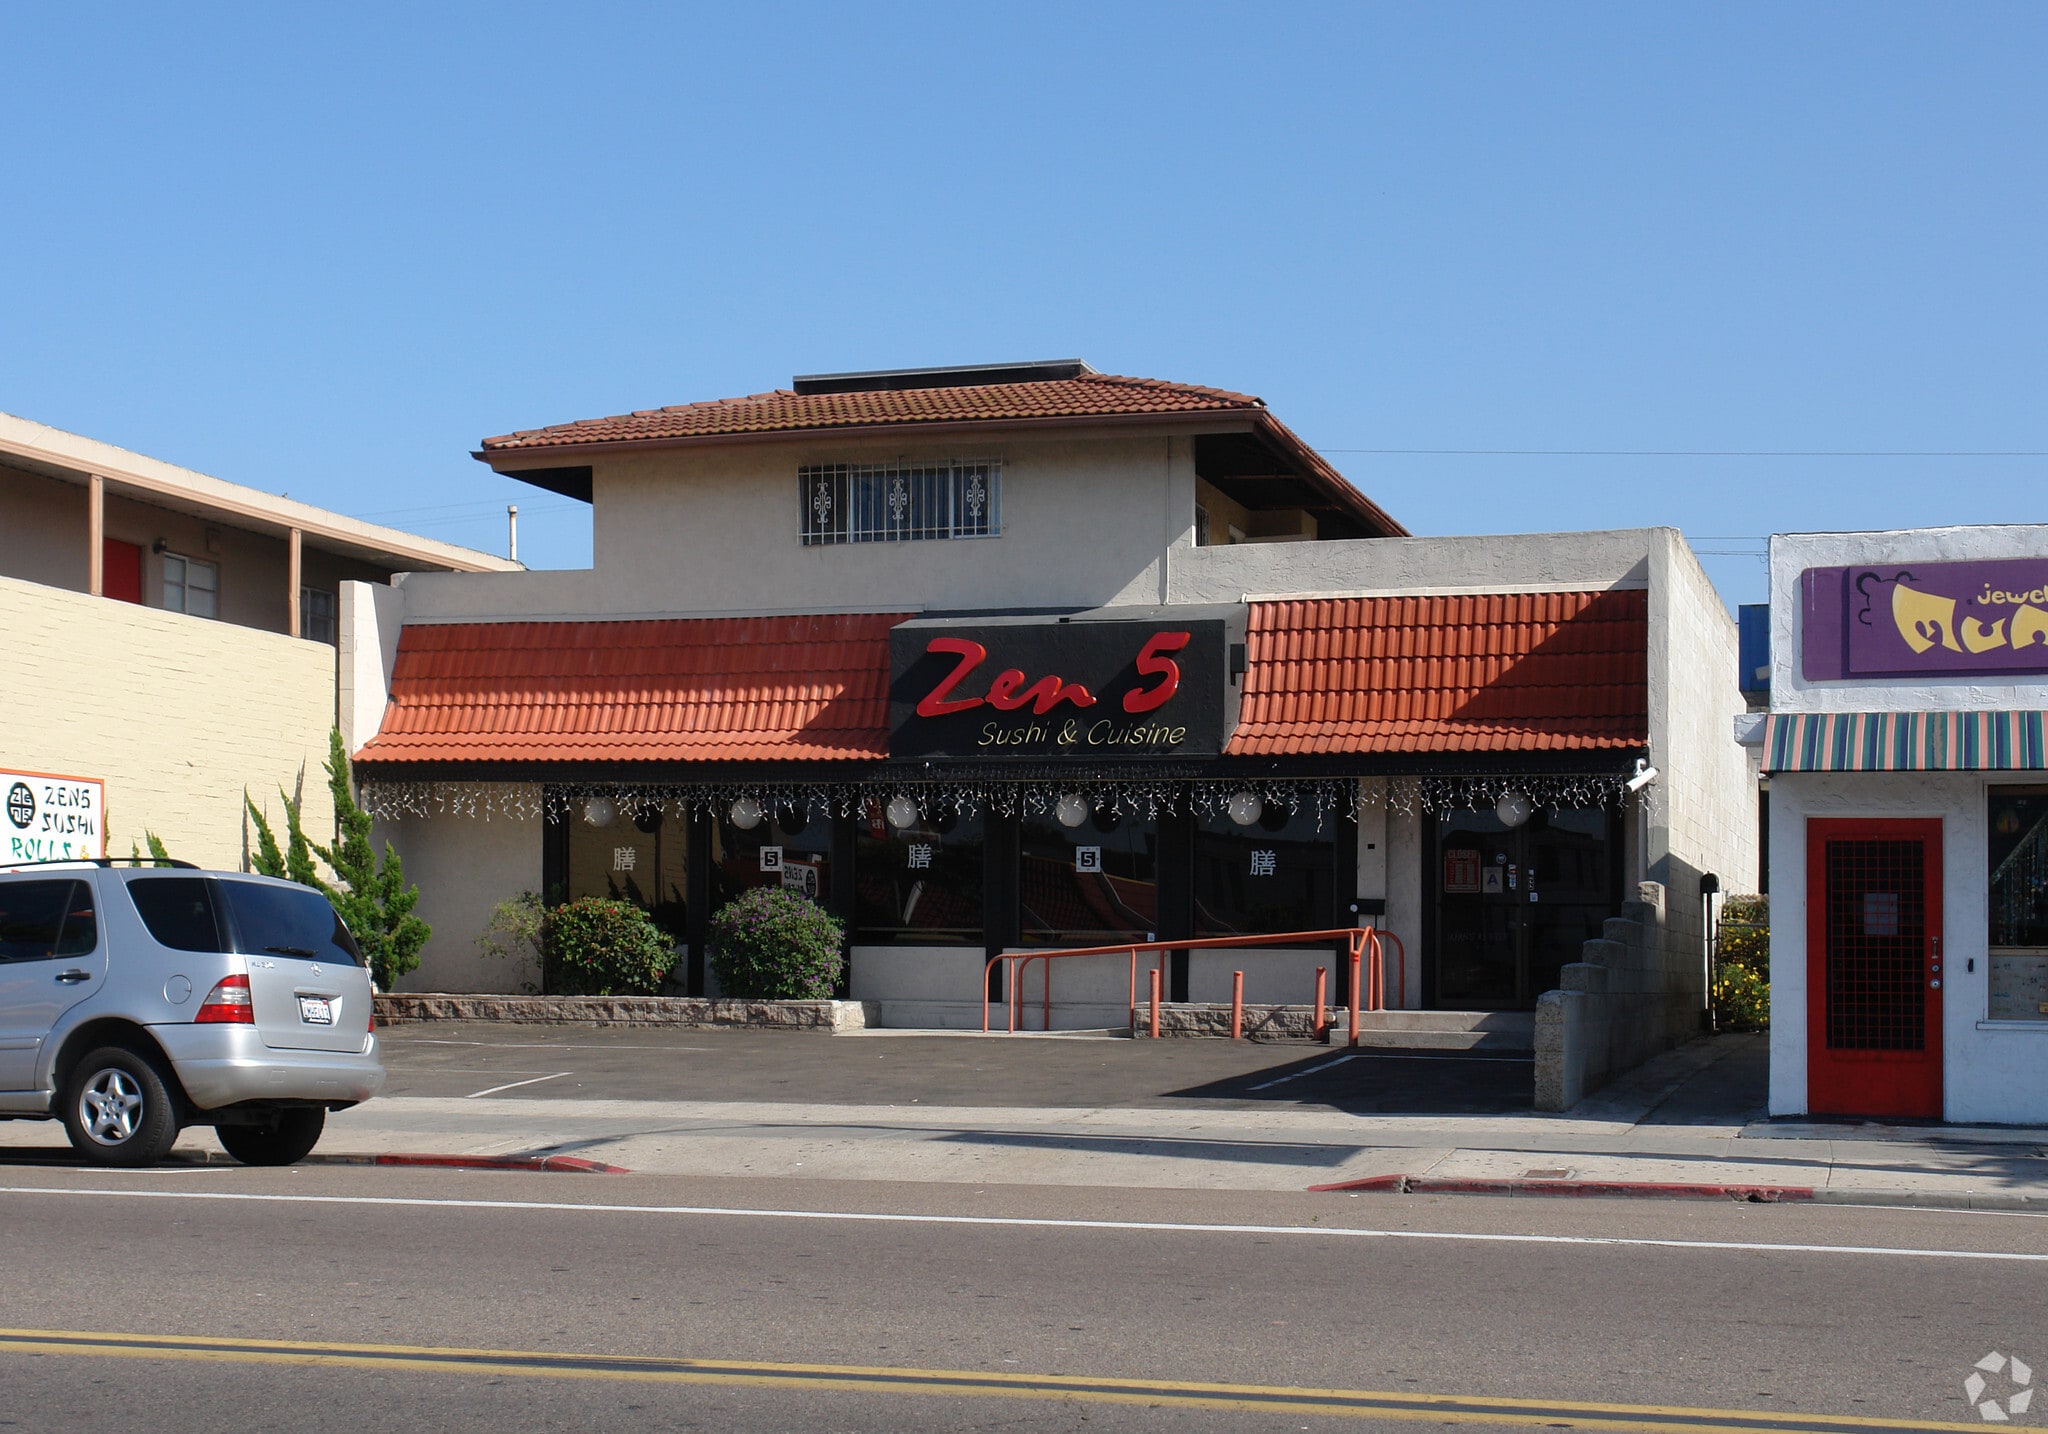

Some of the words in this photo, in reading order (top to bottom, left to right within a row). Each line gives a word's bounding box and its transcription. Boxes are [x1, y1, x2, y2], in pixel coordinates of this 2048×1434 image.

[916, 637, 1097, 717] Zen
[1123, 631, 1191, 713] 5
[977, 721, 1049, 746] Sushi
[1057, 718, 1077, 745] &
[1087, 720, 1186, 745] Cuisine
[42, 812, 94, 835] SUSHI
[11, 837, 72, 862] ROLLS
[766, 853, 777, 866] 5
[1083, 853, 1093, 866] 5
[1487, 873, 1498, 885] A
